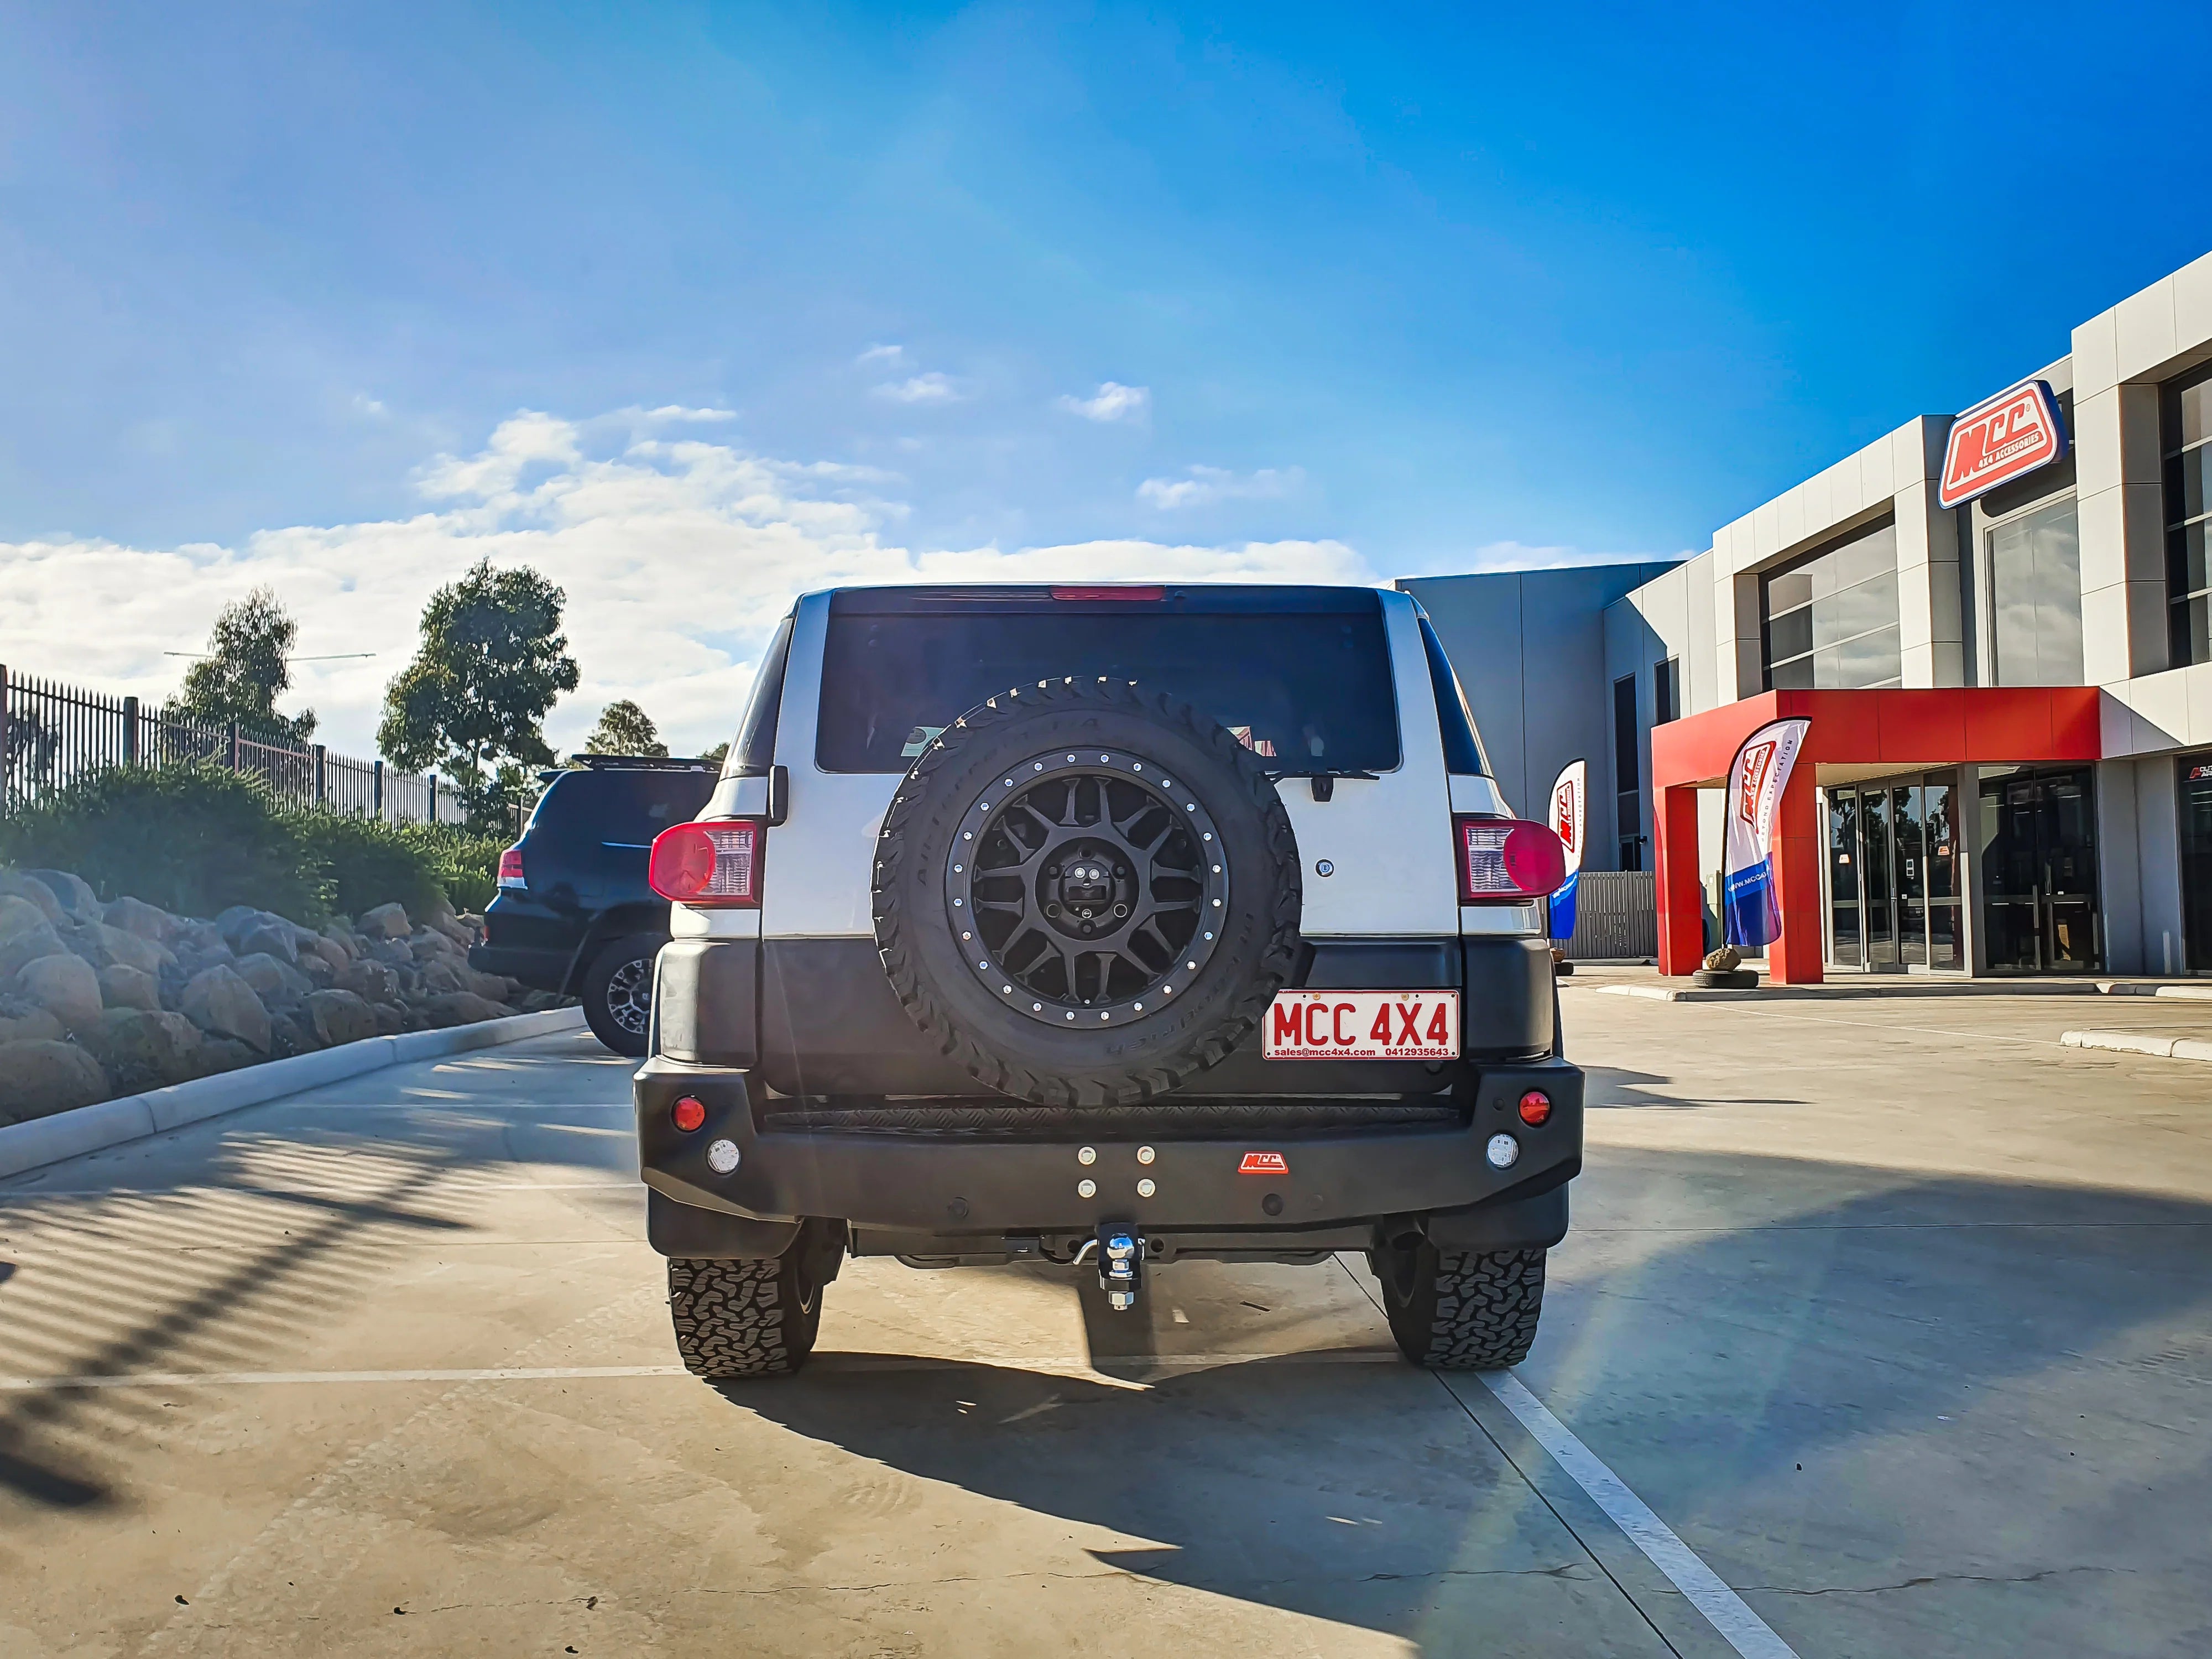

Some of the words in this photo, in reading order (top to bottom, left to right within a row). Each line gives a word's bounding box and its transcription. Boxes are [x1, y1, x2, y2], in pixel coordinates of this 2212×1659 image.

[1949, 403, 2039, 484] MCC
[1978, 455, 1994, 468] 4X4
[1995, 433, 2039, 461] ACCESSORIES
[1559, 787, 1572, 846] MCC
[1274, 1003, 1357, 1046] MCC
[1370, 1003, 1448, 1046] 4X4
[1274, 1047, 1376, 1056] sales@mcc4x4.com
[1385, 1048, 1449, 1056] 0412935643
[1243, 1155, 1282, 1167] MCC
